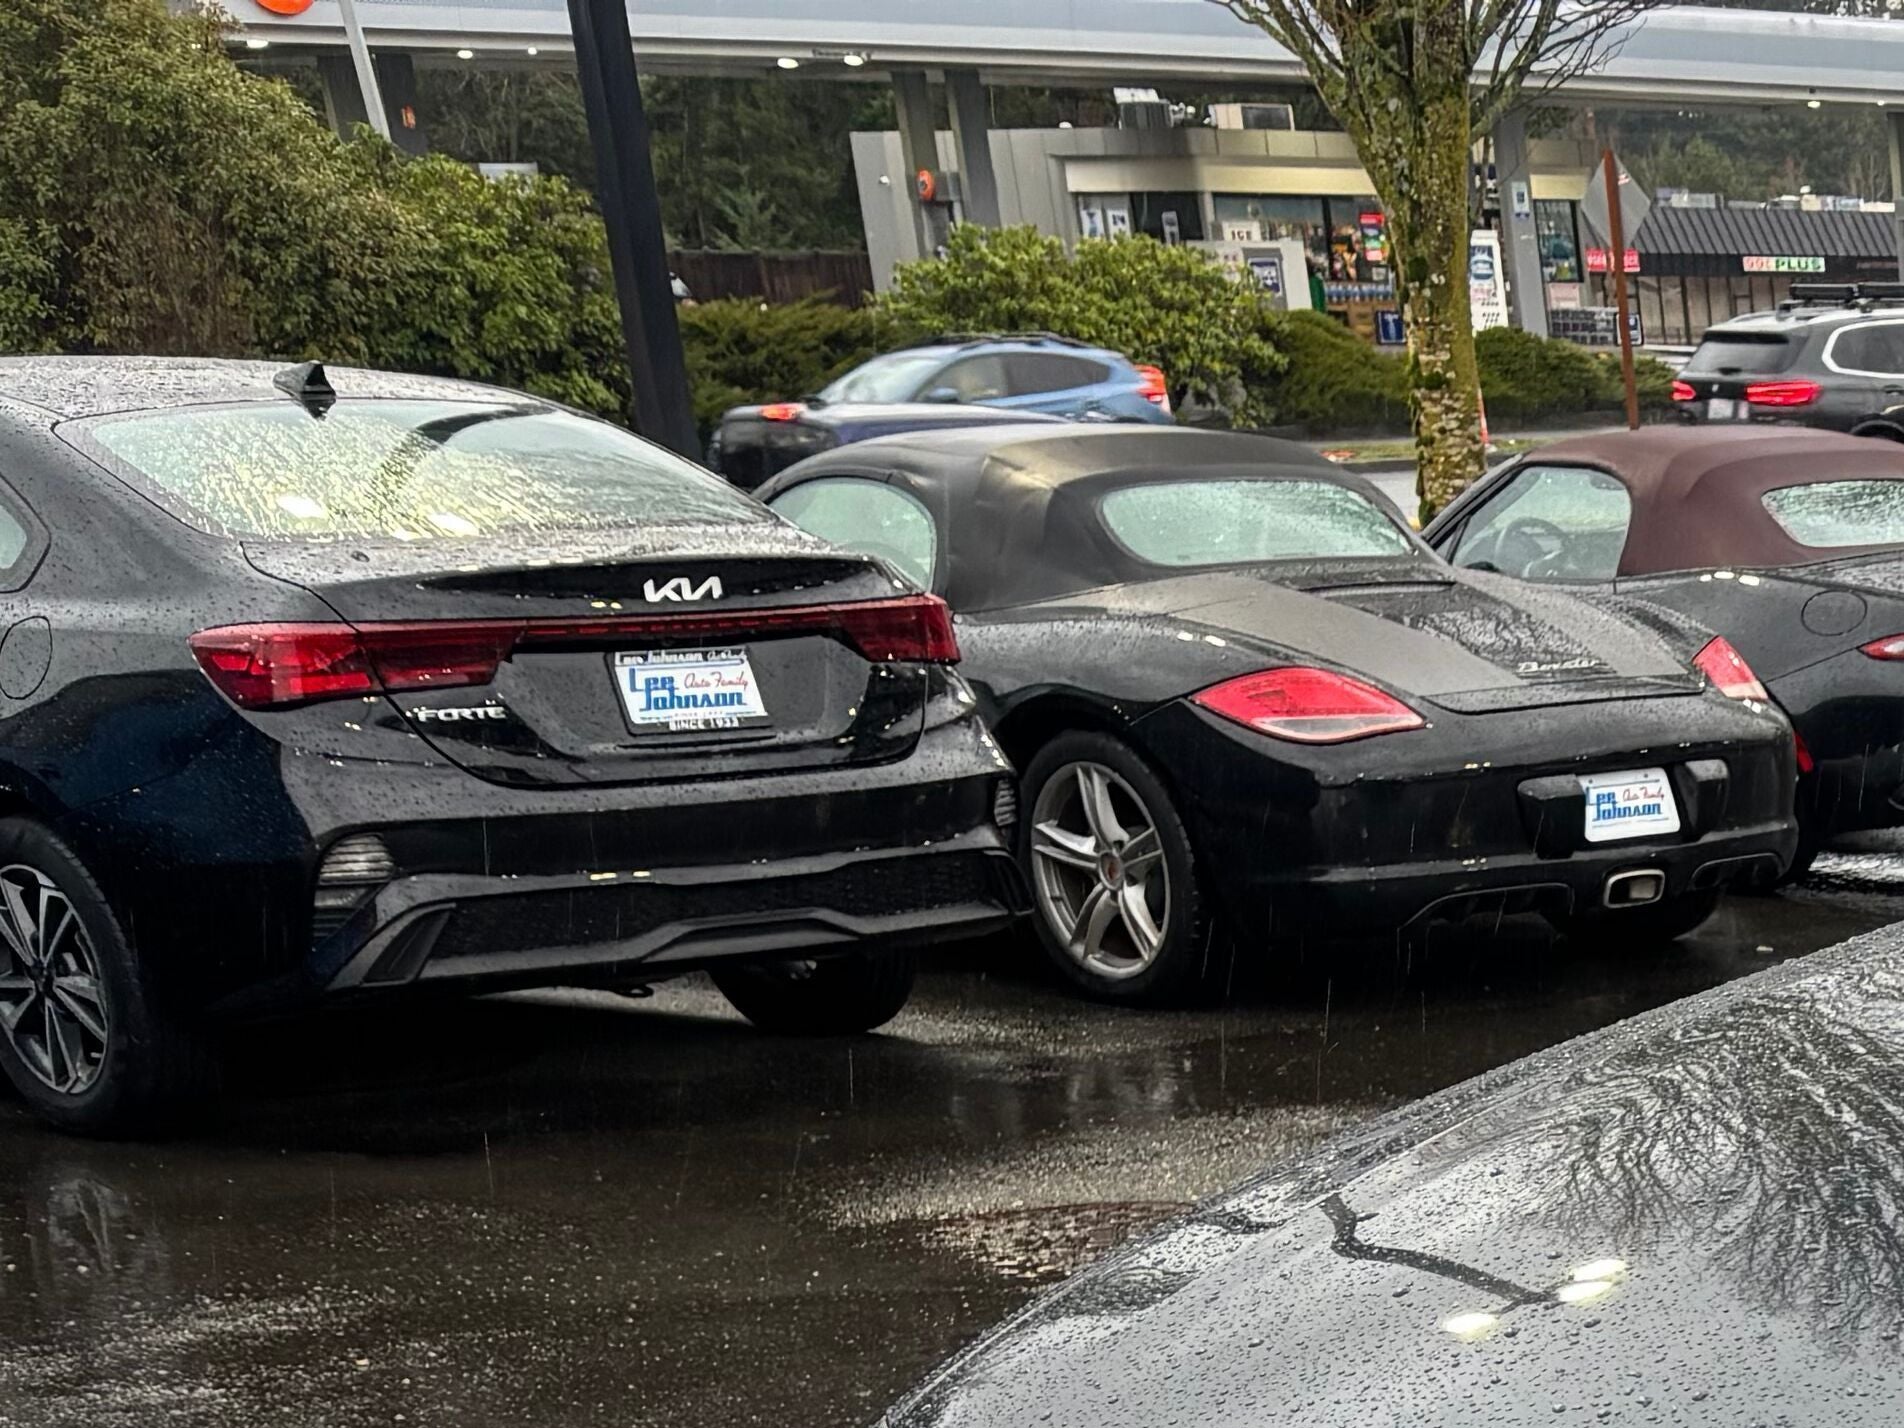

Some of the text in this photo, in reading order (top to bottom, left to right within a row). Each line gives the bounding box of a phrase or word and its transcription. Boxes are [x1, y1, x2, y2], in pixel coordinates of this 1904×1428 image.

[643, 576, 723, 602] KIA
[628, 668, 680, 693] Lee
[639, 688, 748, 712] Johnson
[417, 706, 506, 722] FORTE
[1586, 787, 1618, 806] Lee
[1591, 801, 1663, 822] Johnson
